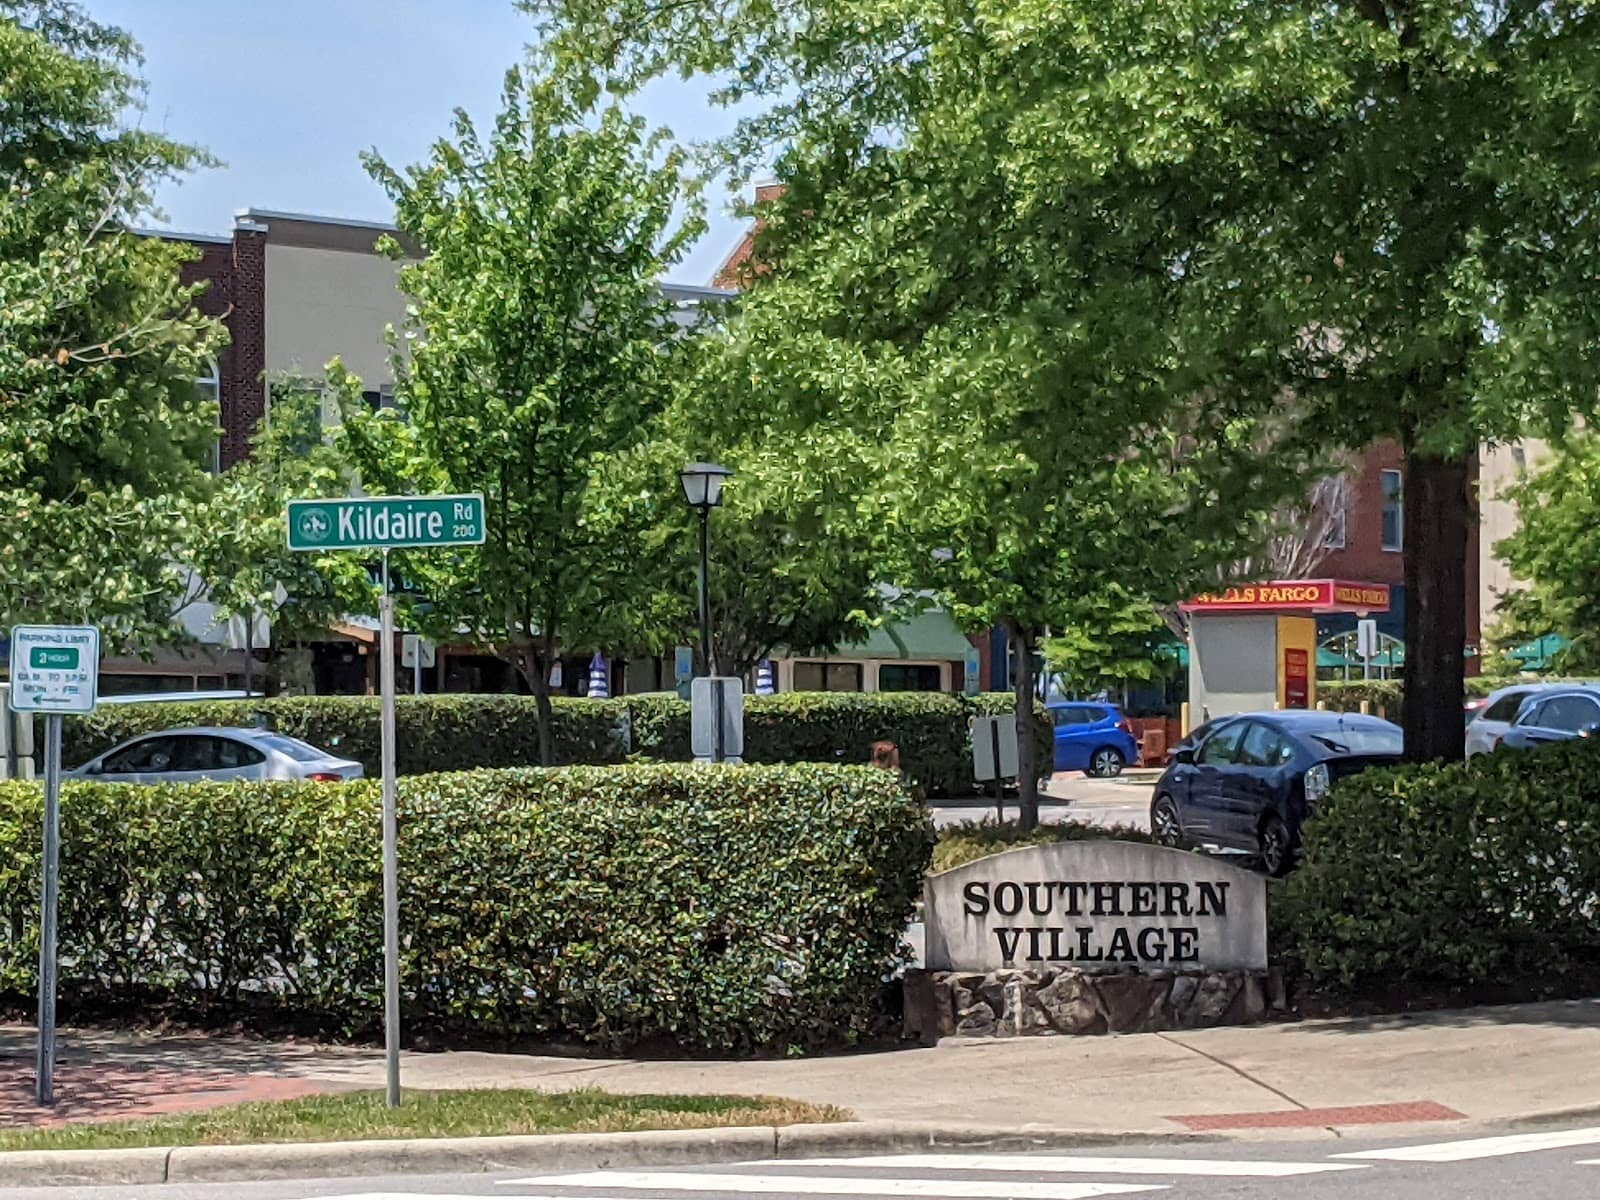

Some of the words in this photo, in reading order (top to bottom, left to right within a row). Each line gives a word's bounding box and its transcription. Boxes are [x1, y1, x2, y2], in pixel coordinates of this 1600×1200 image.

[338, 505, 443, 541] Kildaire
[453, 502, 473, 521] Rd
[452, 524, 476, 537] 200
[1259, 586, 1319, 602] FARGO
[963, 881, 1231, 916] SOUTHERN
[992, 927, 1200, 962] VILLAGE
